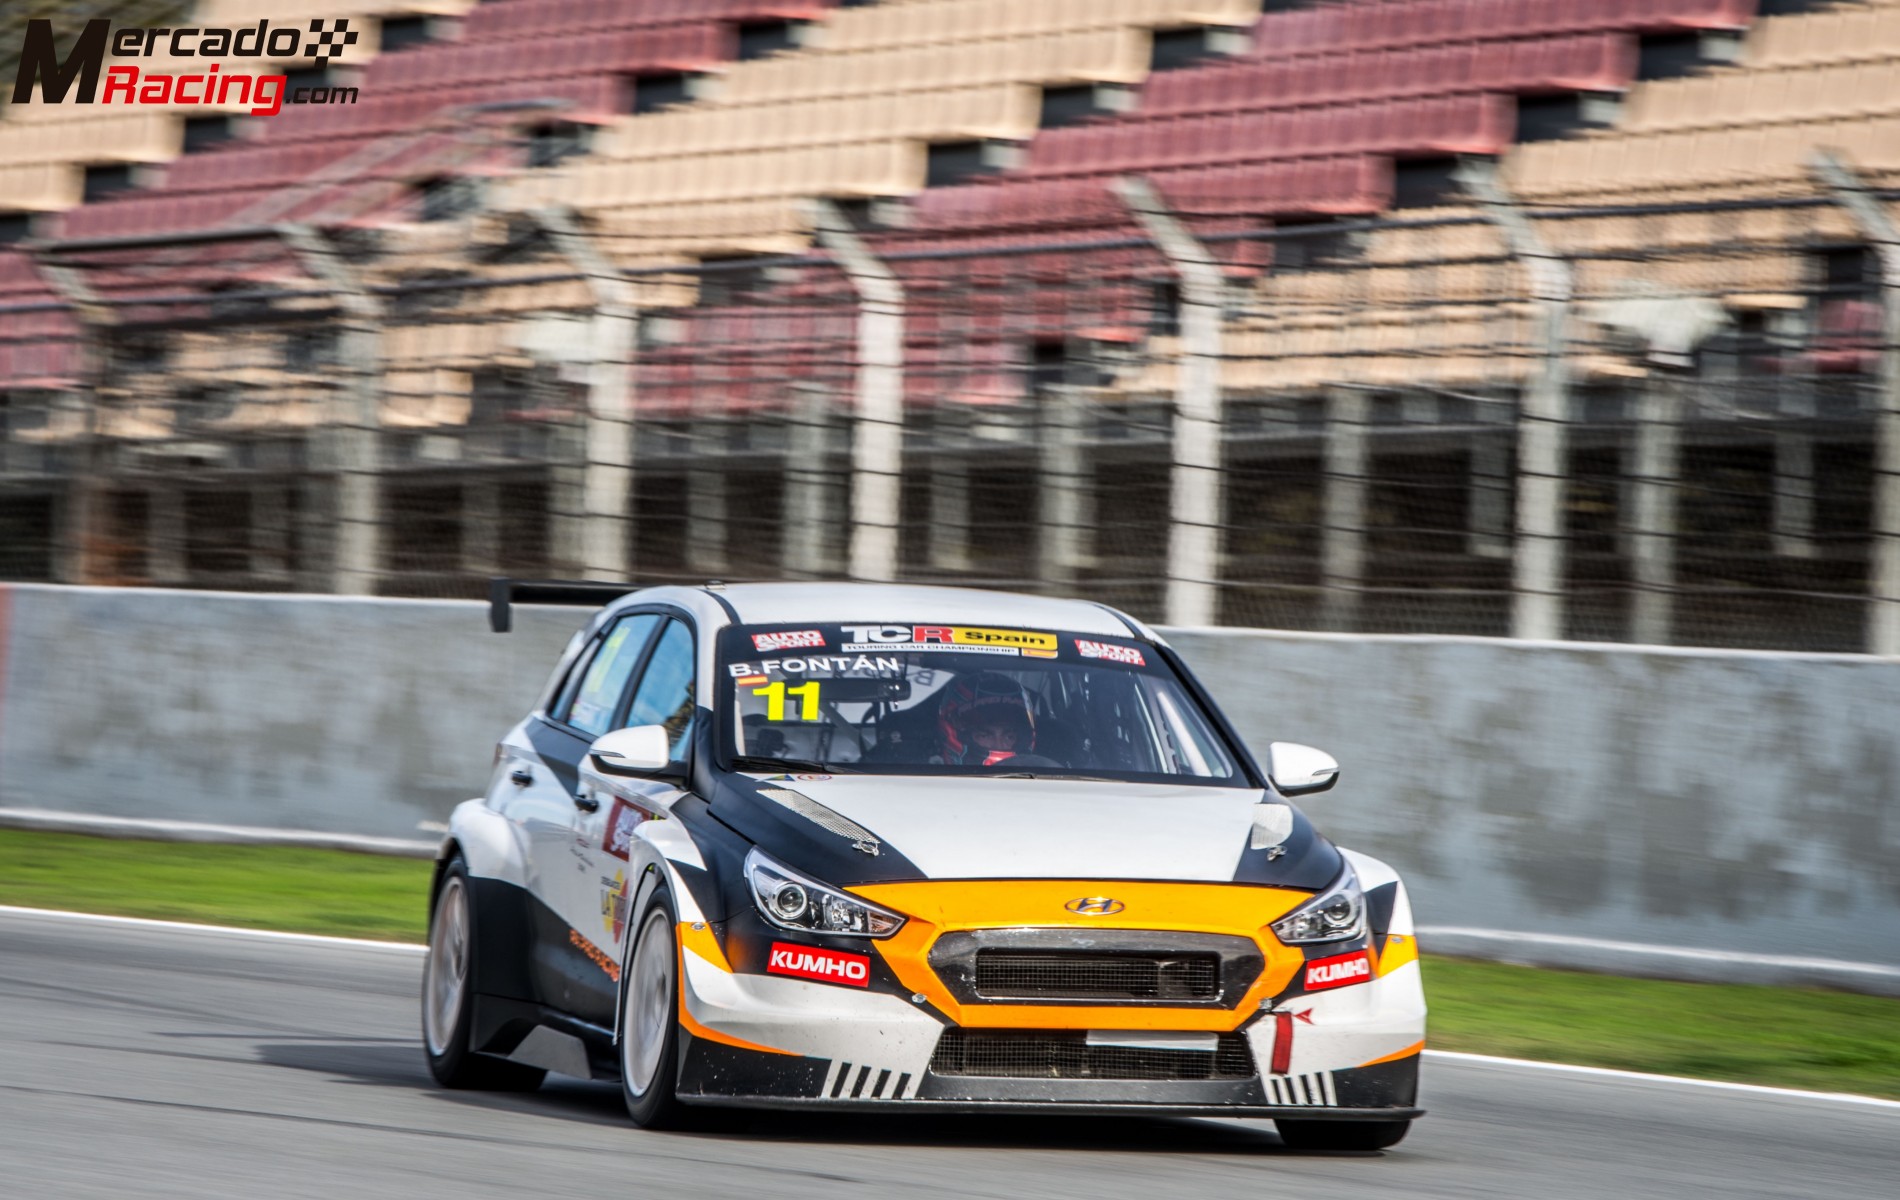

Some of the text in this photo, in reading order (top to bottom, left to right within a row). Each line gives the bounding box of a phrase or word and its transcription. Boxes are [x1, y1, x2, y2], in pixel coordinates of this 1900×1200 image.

[757, 630, 820, 644] AUTO
[841, 625, 954, 643] TCR
[929, 644, 1015, 653] CHAMPIONSHIP
[1079, 640, 1141, 656] AUTO
[753, 681, 820, 721] 11
[770, 950, 866, 980] KUMHO
[1307, 957, 1369, 984] KUMHO
